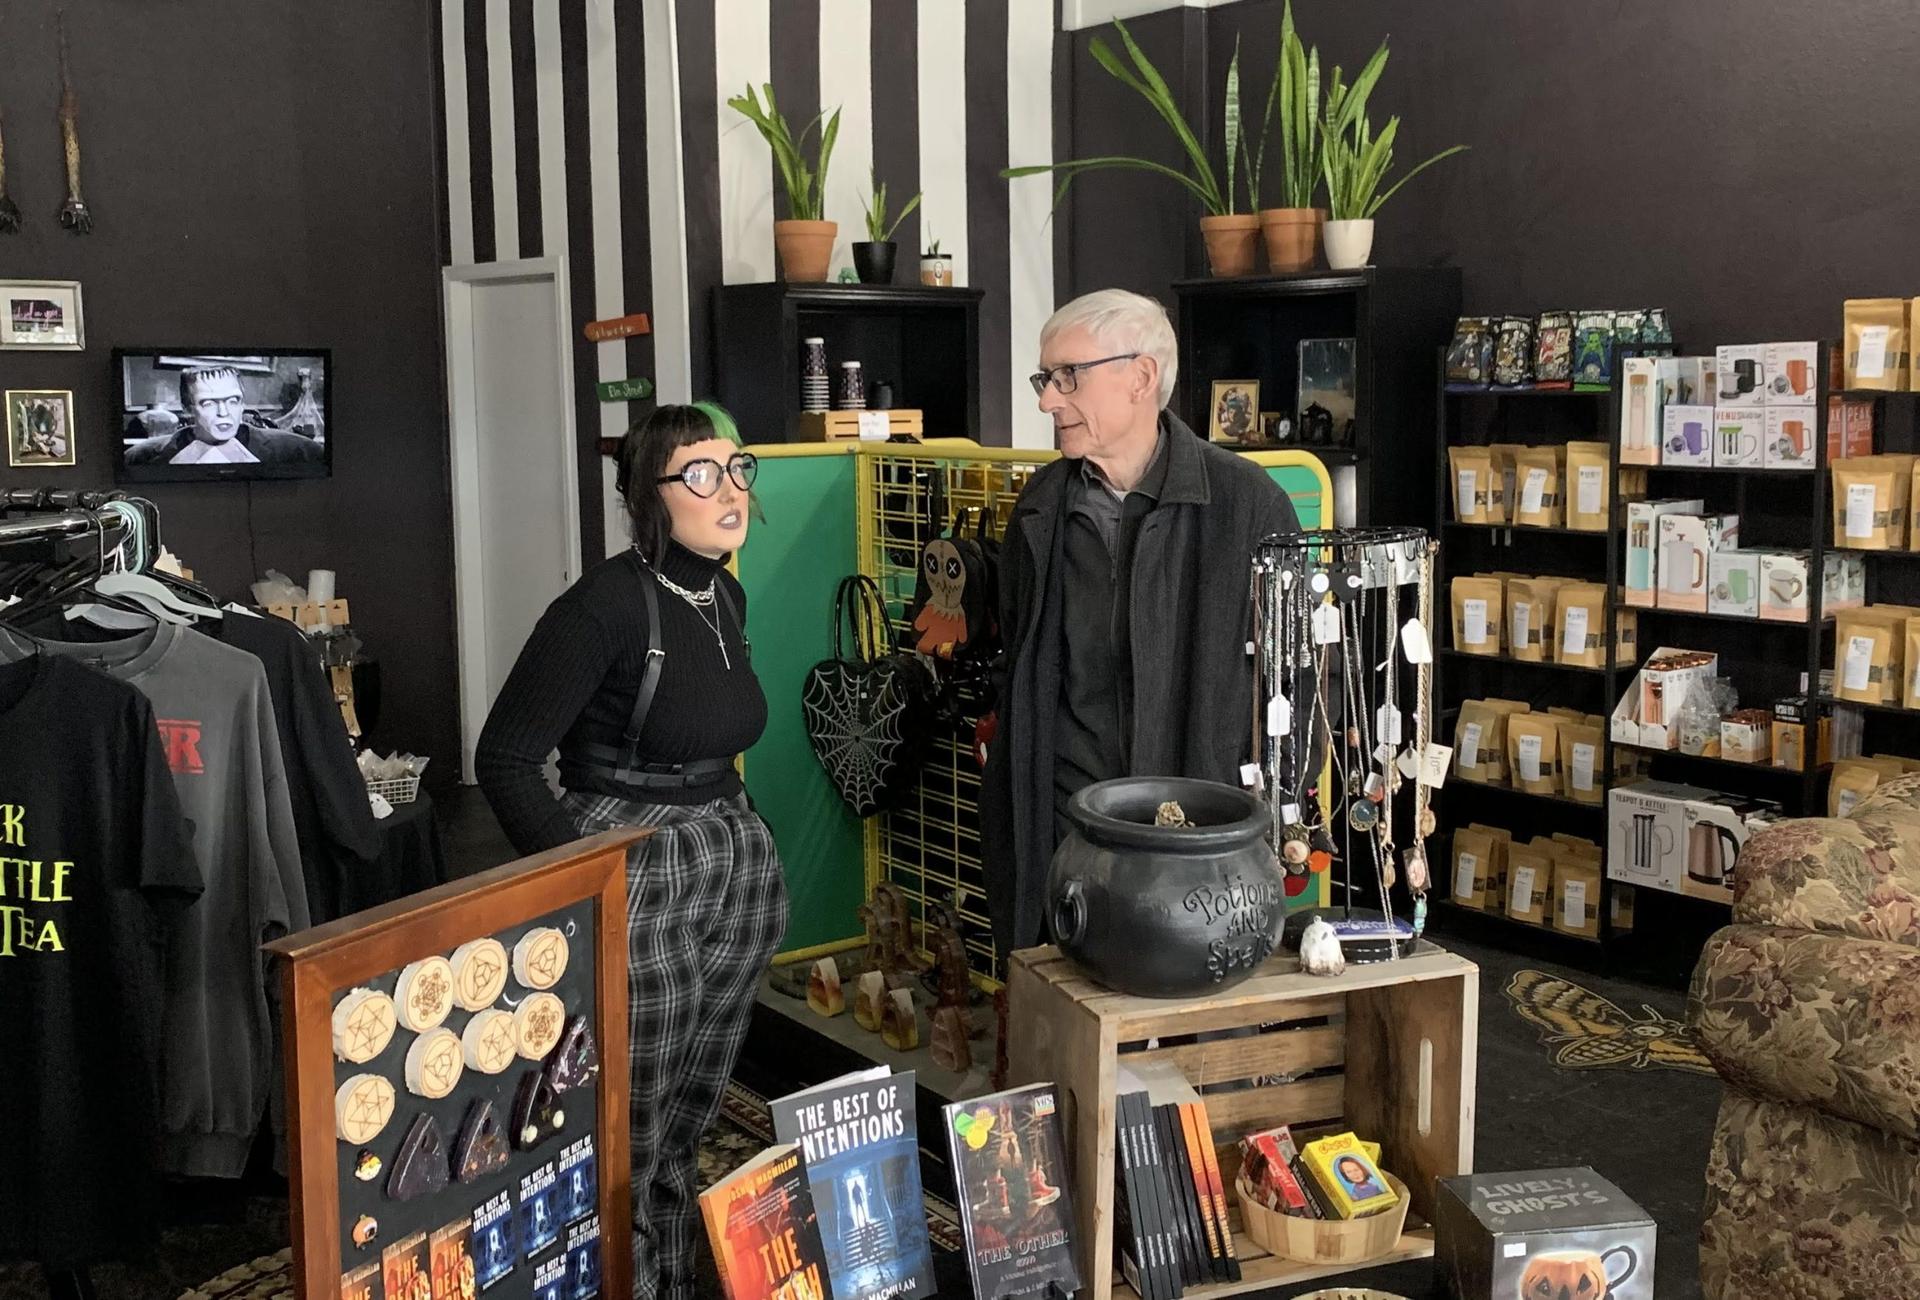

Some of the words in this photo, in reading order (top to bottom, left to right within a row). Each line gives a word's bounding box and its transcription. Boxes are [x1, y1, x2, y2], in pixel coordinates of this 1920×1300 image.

[1183, 874, 1280, 925] Potions
[1227, 908, 1268, 938] AND
[796, 1103, 826, 1133] THE
[833, 1092, 869, 1122] BEST
[877, 1086, 897, 1110] OF
[559, 1144, 593, 1173] INTENTIONS
[560, 1146, 571, 1159] THE
[571, 1139, 583, 1152] BEST
[584, 1134, 592, 1145] OF
[521, 1175, 532, 1190] THE
[532, 1166, 545, 1181] BEST
[546, 1161, 553, 1173] OF
[756, 1155, 798, 1186] MACMILLAN
[520, 1170, 556, 1203] INTENTIONS
[473, 1200, 511, 1233] INTENTIONS
[474, 1206, 485, 1219] THE
[486, 1195, 499, 1209] BEST
[500, 1190, 508, 1201] OF
[1486, 1190, 1609, 1215] GHOSTS
[567, 1224, 600, 1252] INTENTIONS
[568, 1226, 579, 1238] THE
[580, 1220, 591, 1233] BEST
[592, 1215, 599, 1226] OF
[443, 1240, 465, 1271] THE
[536, 1264, 546, 1277] THE
[547, 1257, 559, 1270] BEST
[560, 1253, 567, 1264] OF
[758, 1227, 802, 1285] THE
[978, 1245, 1012, 1266] THE
